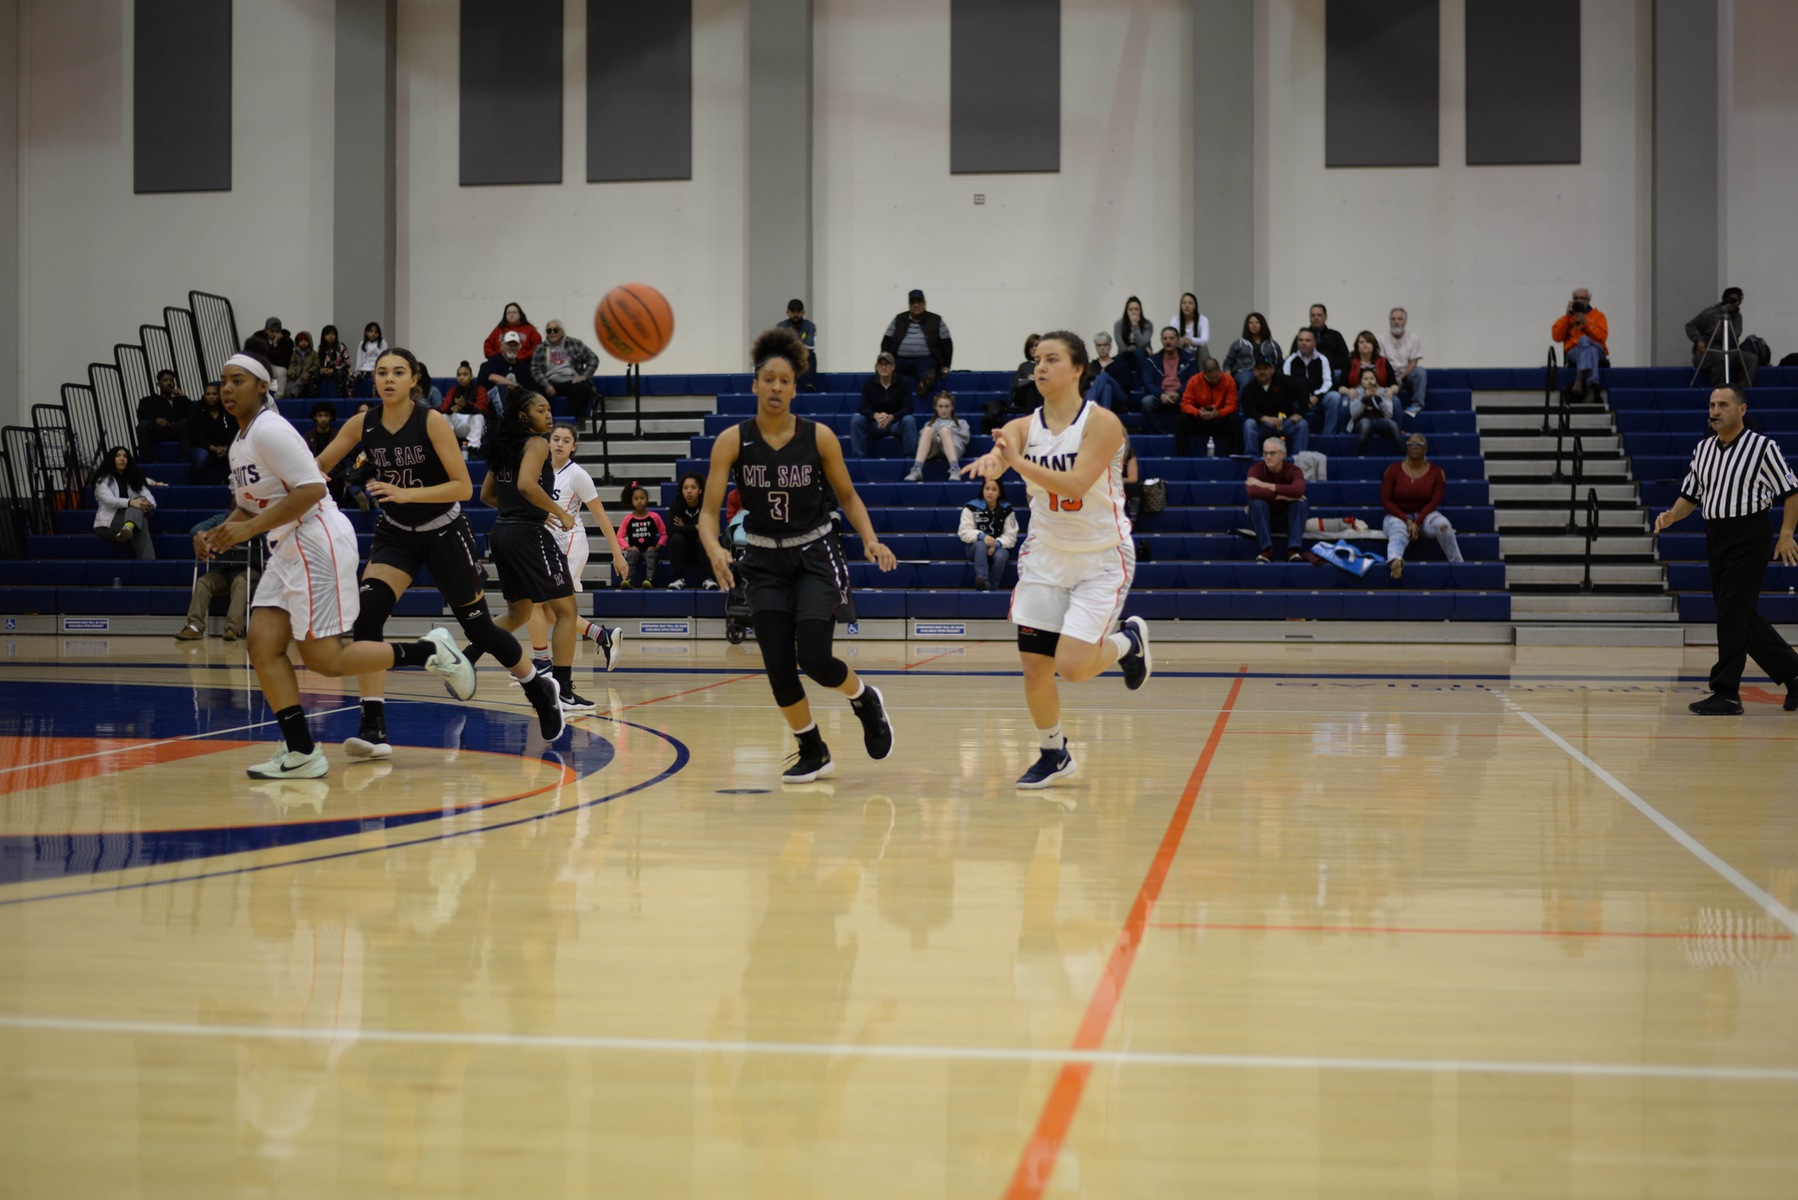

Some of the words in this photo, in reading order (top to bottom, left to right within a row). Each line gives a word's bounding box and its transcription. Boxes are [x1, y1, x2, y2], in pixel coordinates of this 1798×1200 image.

[394, 445, 425, 466] SAC
[743, 465, 771, 487] MT.
[778, 465, 812, 488] SAC
[767, 491, 789, 523] 3
